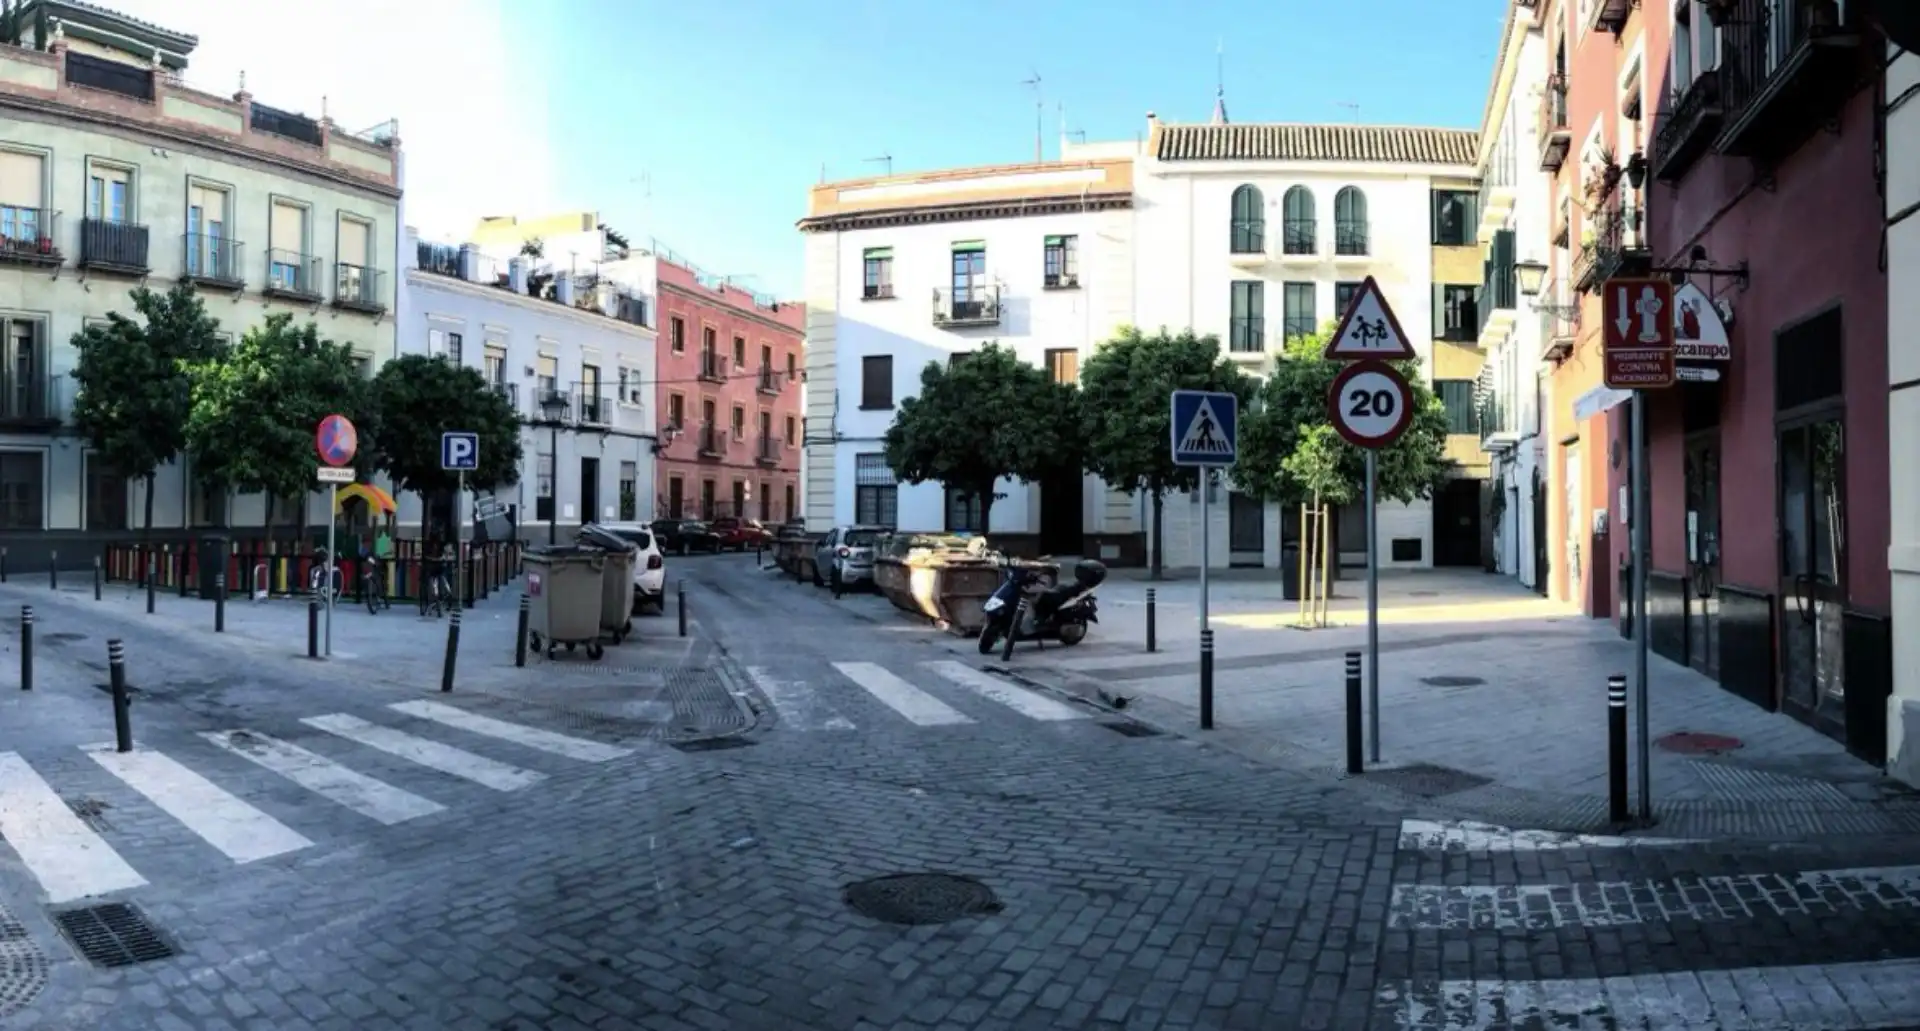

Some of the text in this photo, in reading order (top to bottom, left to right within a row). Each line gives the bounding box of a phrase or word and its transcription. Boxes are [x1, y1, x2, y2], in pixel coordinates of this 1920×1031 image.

[1618, 362, 1662, 372] CONTRA
[1349, 389, 1395, 417] 20
[450, 437, 472, 465] P
